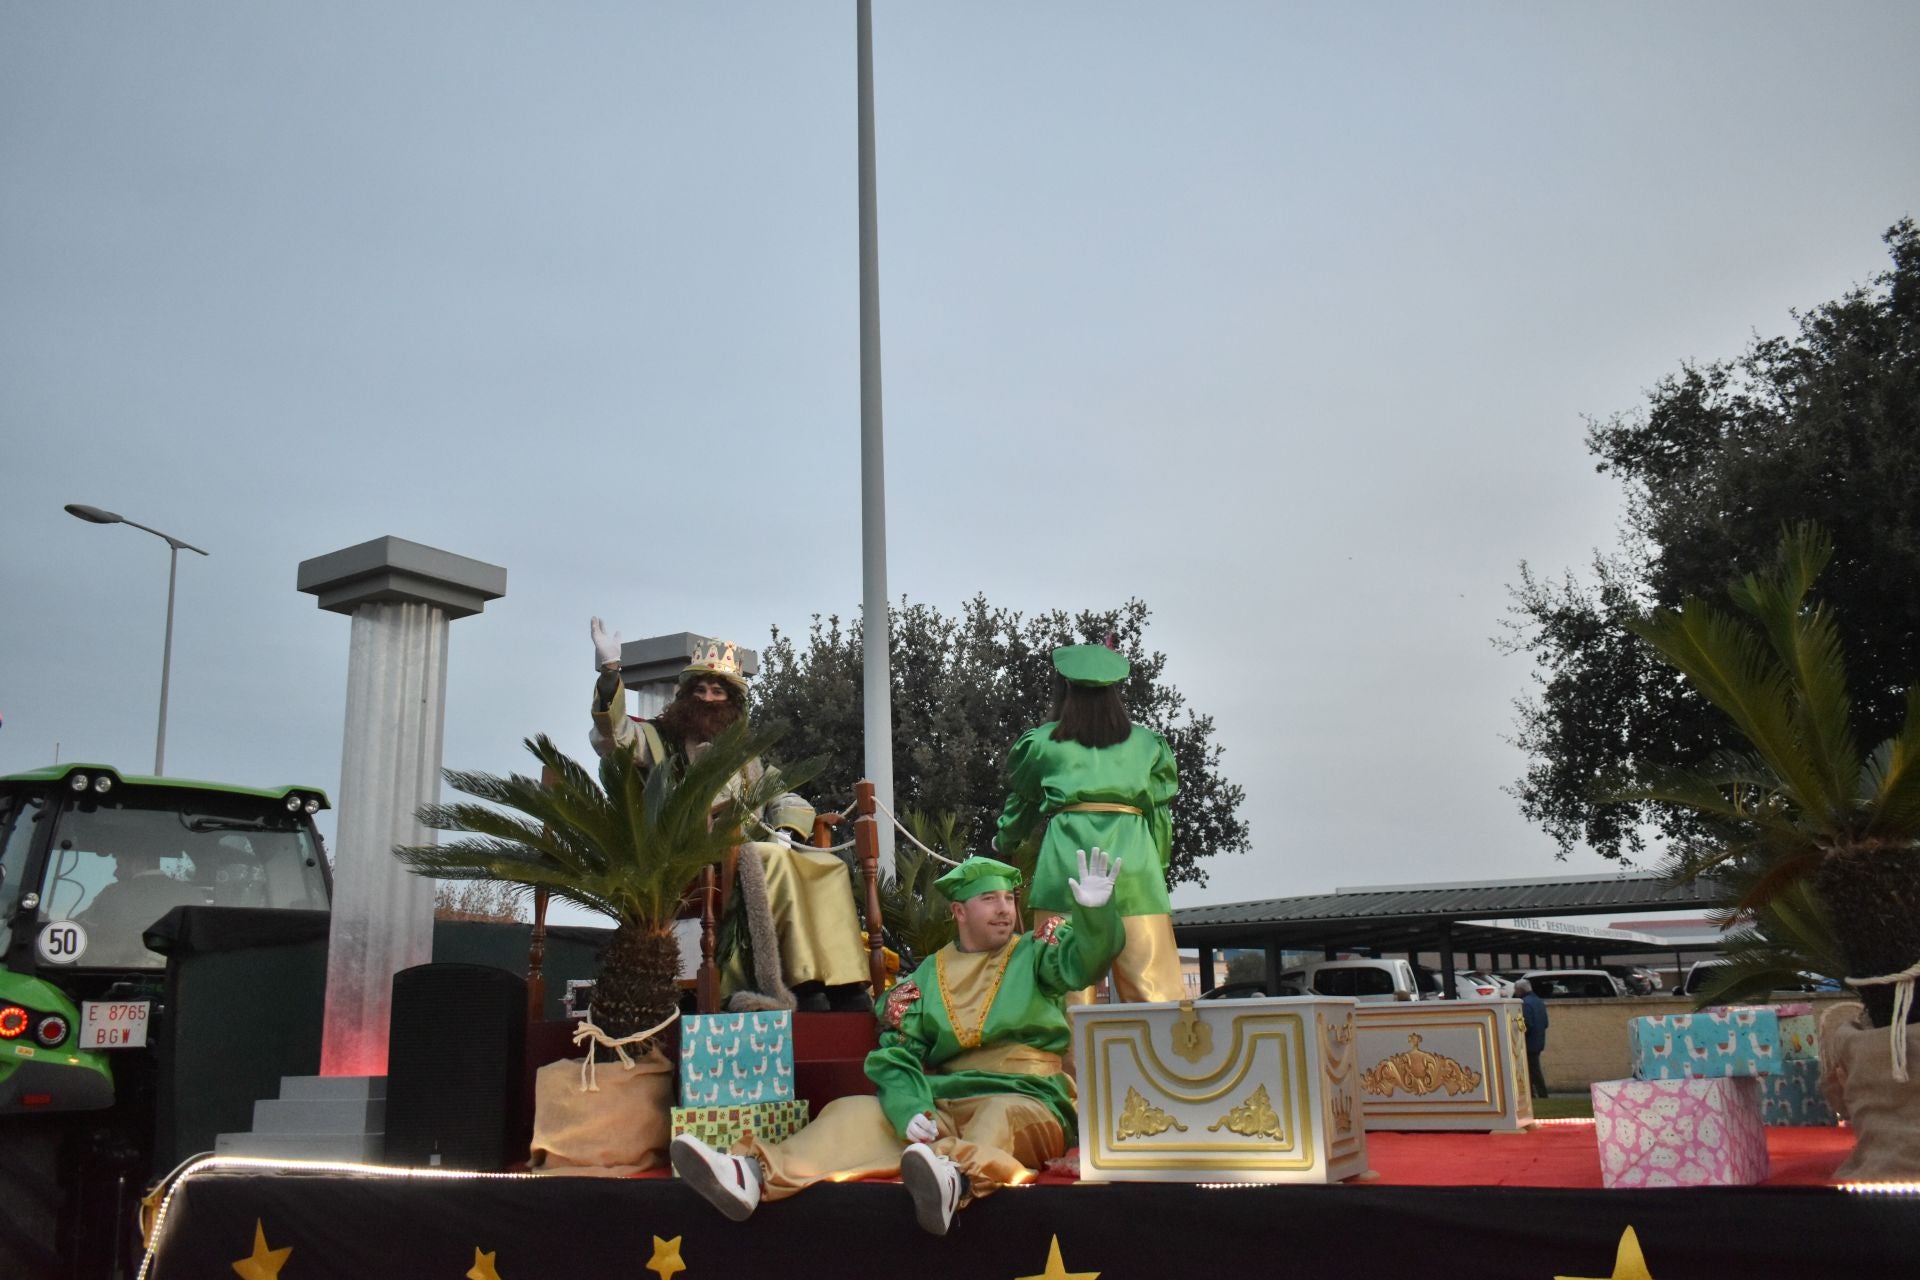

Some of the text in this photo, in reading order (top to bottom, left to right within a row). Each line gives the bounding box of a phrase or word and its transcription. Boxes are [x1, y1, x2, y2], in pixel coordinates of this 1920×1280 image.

[1513, 917, 1540, 930] HOTEL
[50, 928, 77, 955] 50
[89, 1004, 147, 1021] E 8765
[96, 1028, 131, 1044] BGW
